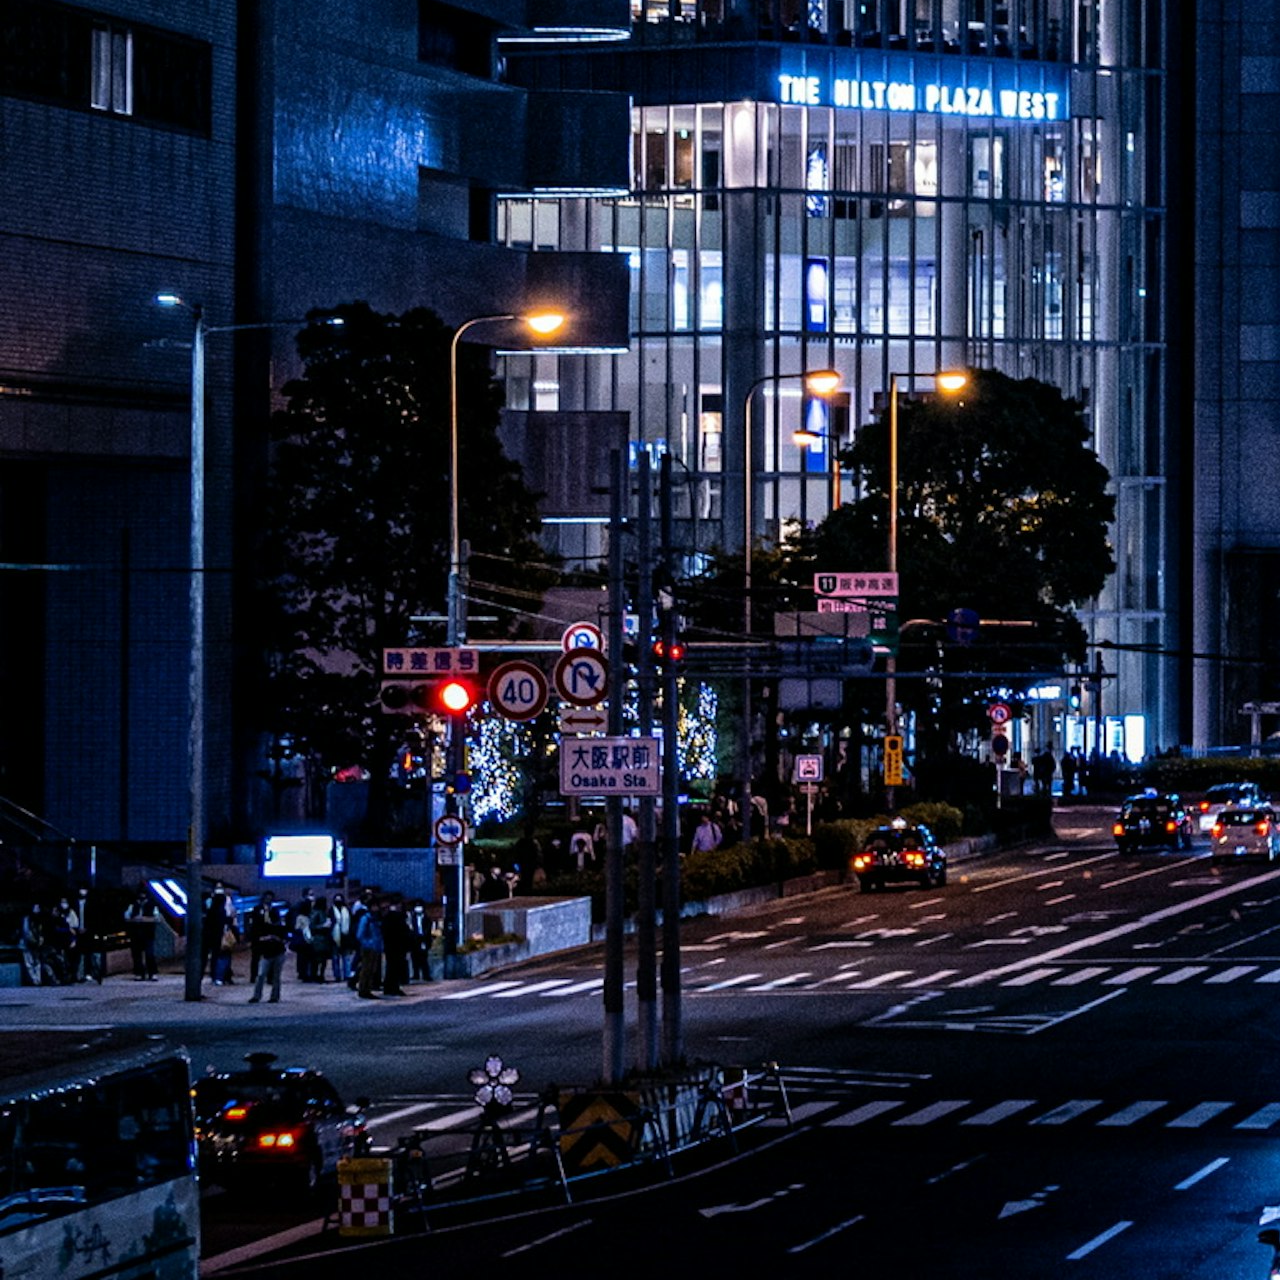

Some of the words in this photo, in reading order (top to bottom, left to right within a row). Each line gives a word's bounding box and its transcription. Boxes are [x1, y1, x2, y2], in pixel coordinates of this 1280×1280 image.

[779, 75, 820, 104] THE
[834, 78, 915, 111] HILTON
[926, 84, 992, 115] PLAZA
[1000, 90, 1058, 120] WEST
[821, 578, 833, 589] 11
[386, 652, 476, 670] 時差信号
[504, 679, 533, 704] 40
[572, 746, 650, 770] 大阪駅前
[571, 775, 616, 787] Osaka
[624, 774, 651, 787] Sta.
